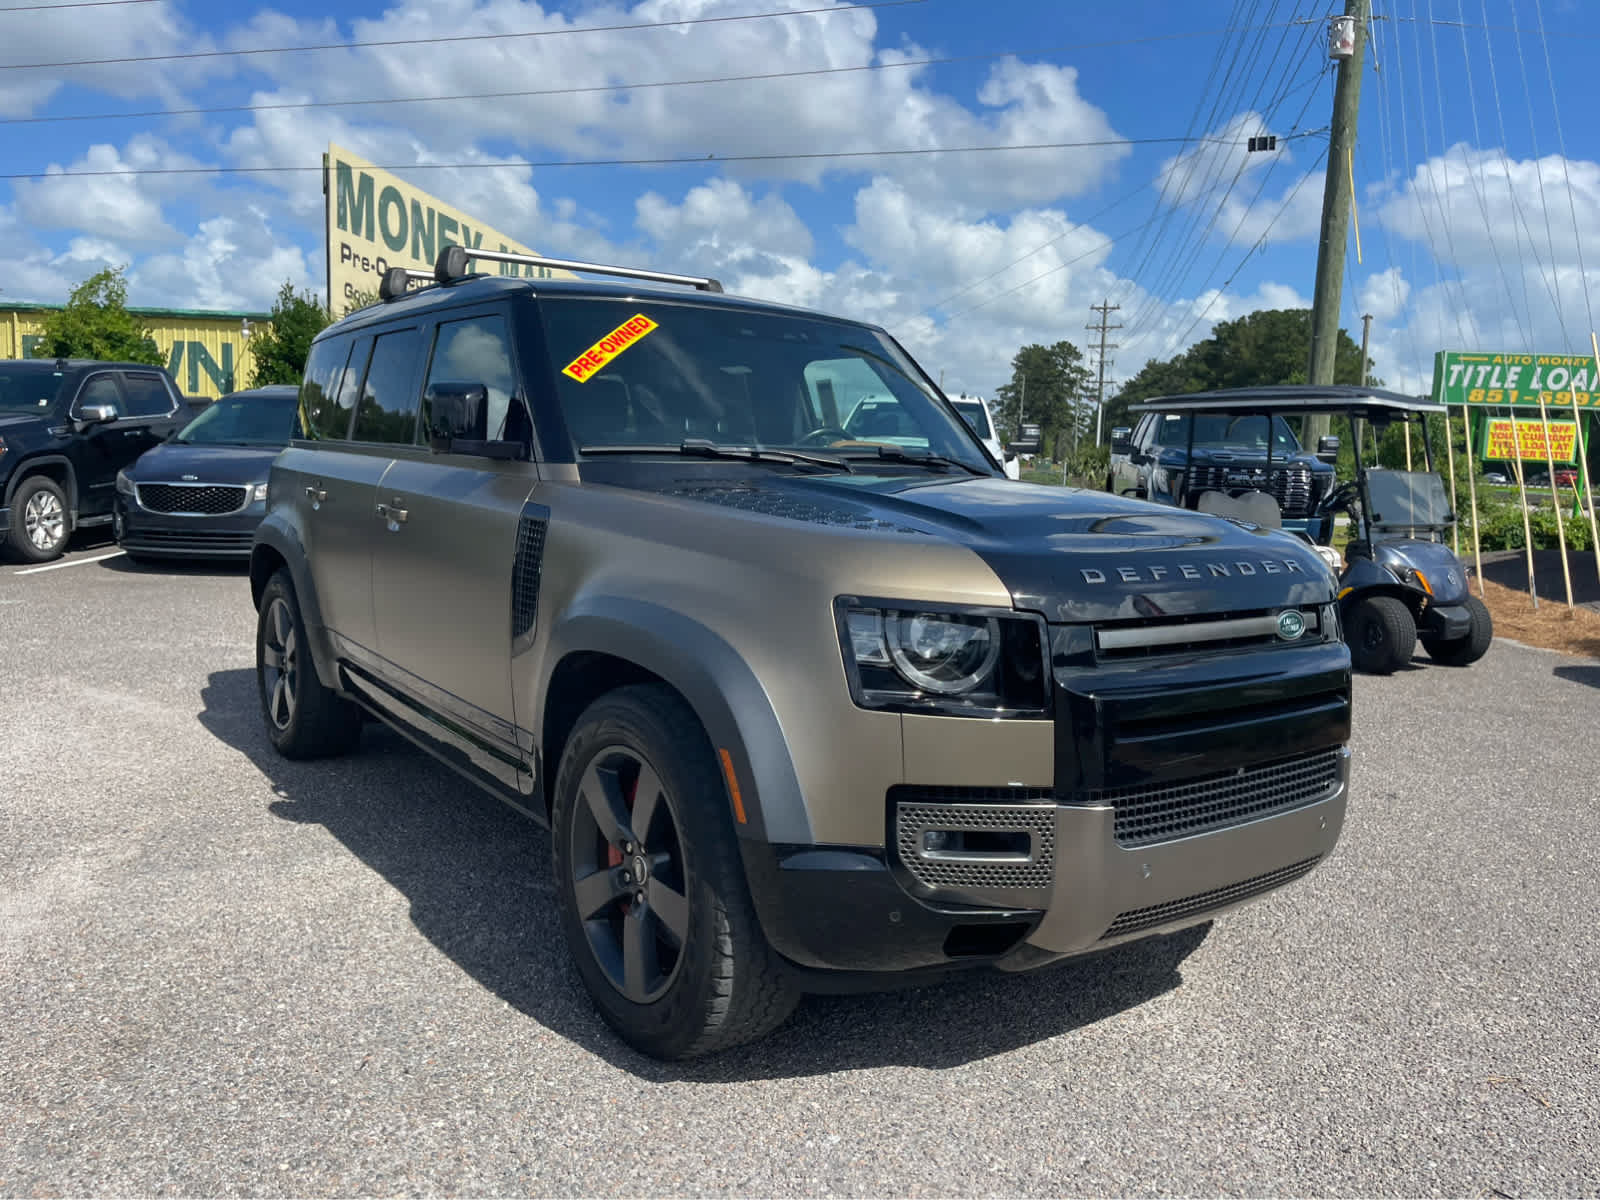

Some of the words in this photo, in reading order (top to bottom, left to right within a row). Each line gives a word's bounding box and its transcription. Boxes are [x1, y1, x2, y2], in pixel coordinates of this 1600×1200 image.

[336, 159, 483, 275] MONEY
[568, 317, 650, 378] PRE-OWNED
[1493, 355, 1532, 366] AUTO
[1538, 356, 1591, 367] MONEY
[1448, 365, 1522, 389] TITLE
[1080, 559, 1304, 584] DEFENDER
